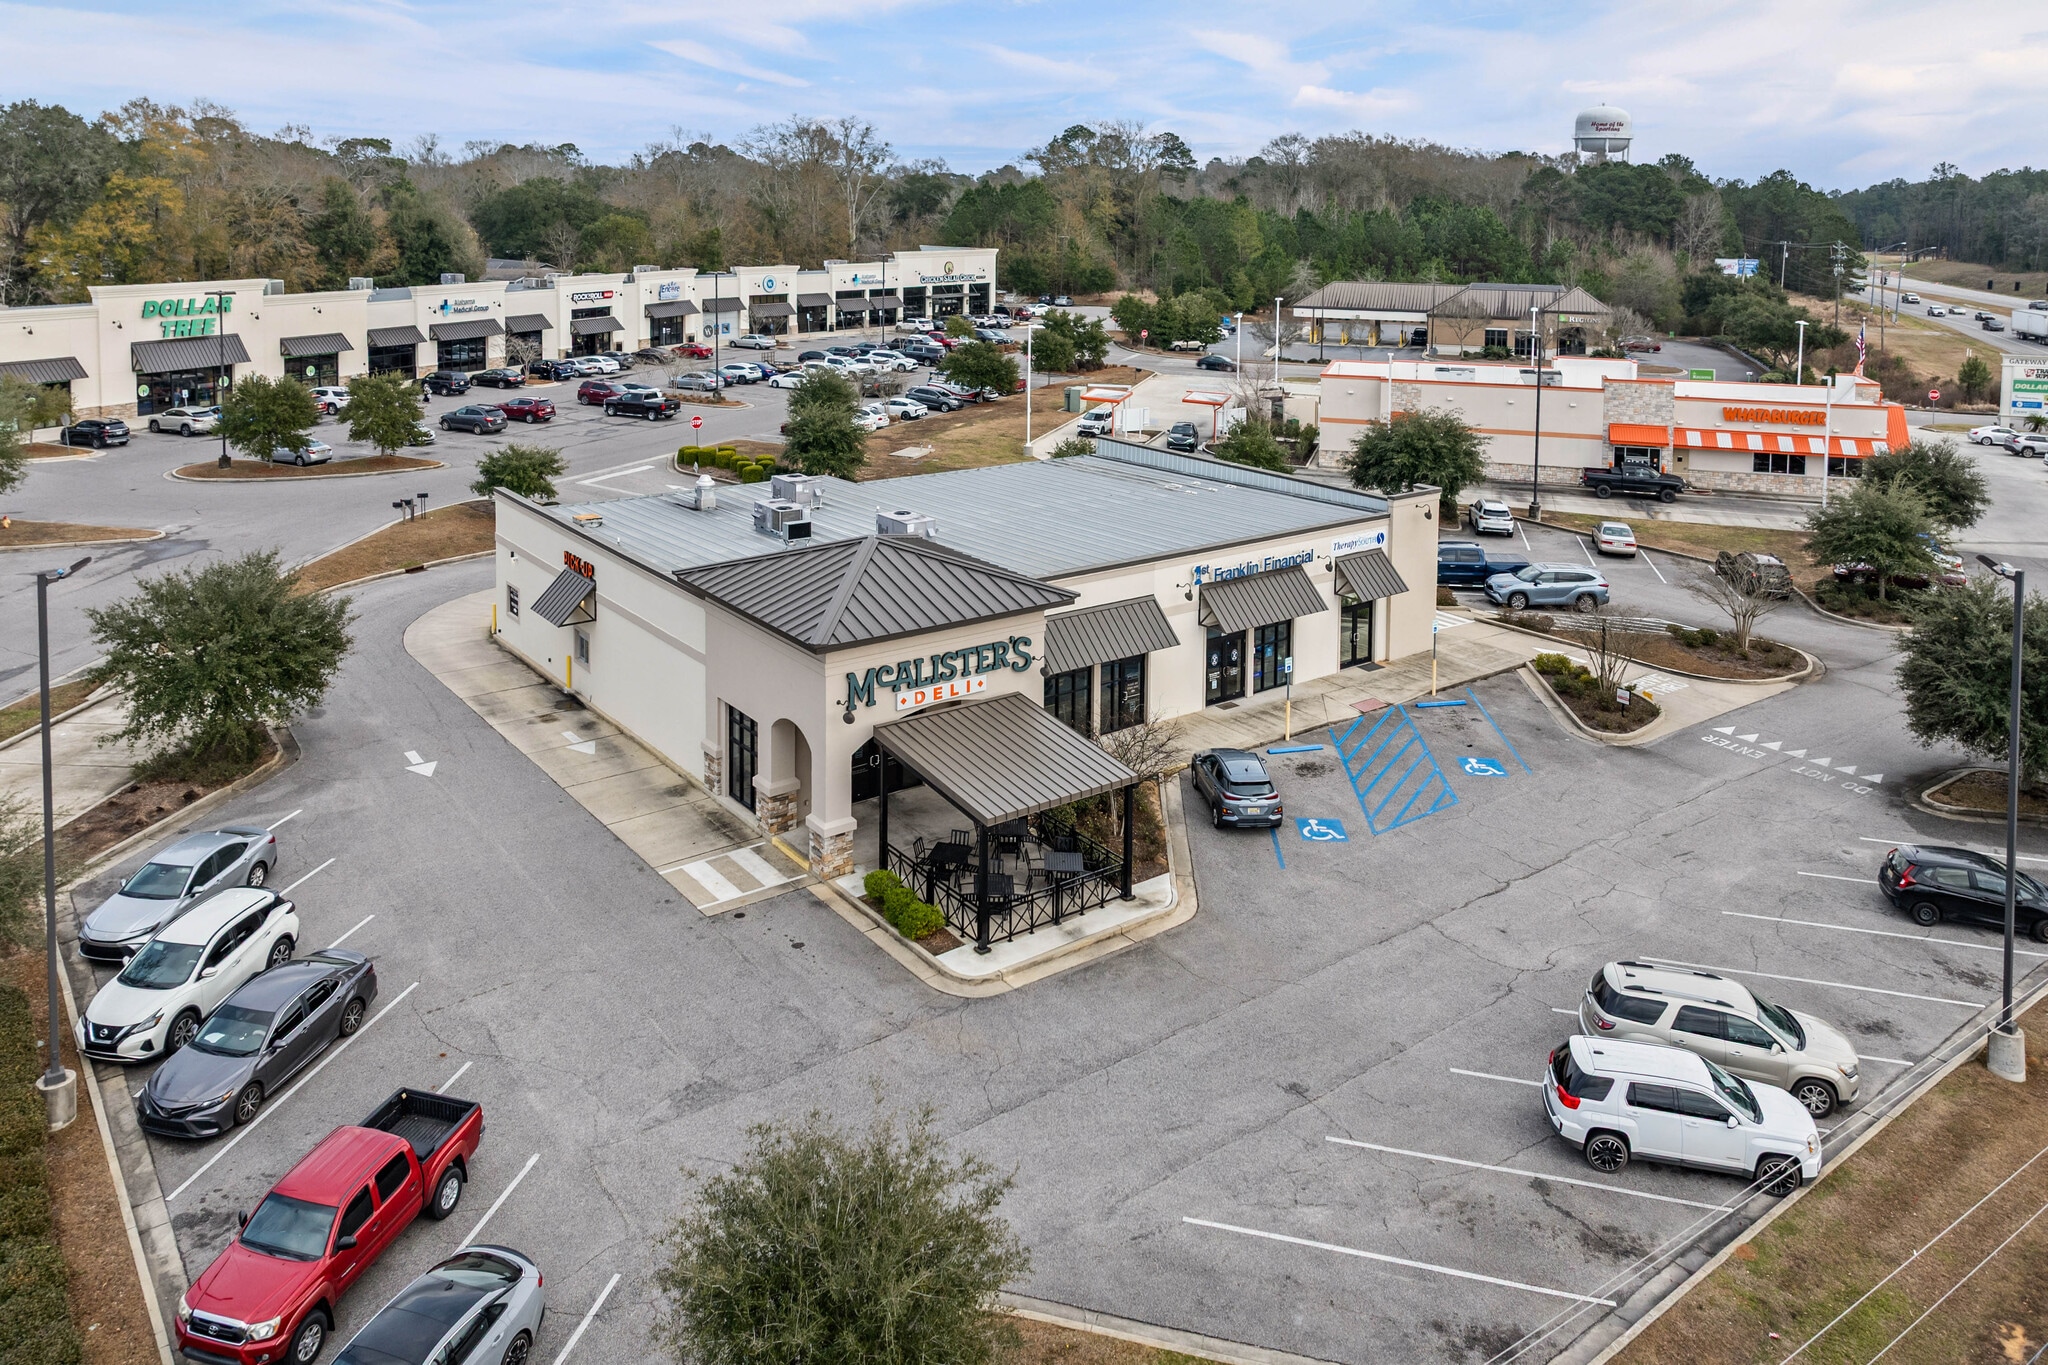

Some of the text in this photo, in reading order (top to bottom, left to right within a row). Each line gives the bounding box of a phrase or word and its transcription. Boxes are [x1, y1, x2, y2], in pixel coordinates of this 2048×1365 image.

[142, 297, 232, 319] DOLLAR
[160, 318, 216, 338] TREE
[1722, 406, 1827, 427] WHATABURGER
[563, 550, 594, 579] PICK-UP
[1213, 561, 1259, 582] Franklin
[1263, 548, 1314, 572] Financial
[914, 680, 971, 705] DELI
[1701, 734, 1873, 795] DO NOT ENTER
